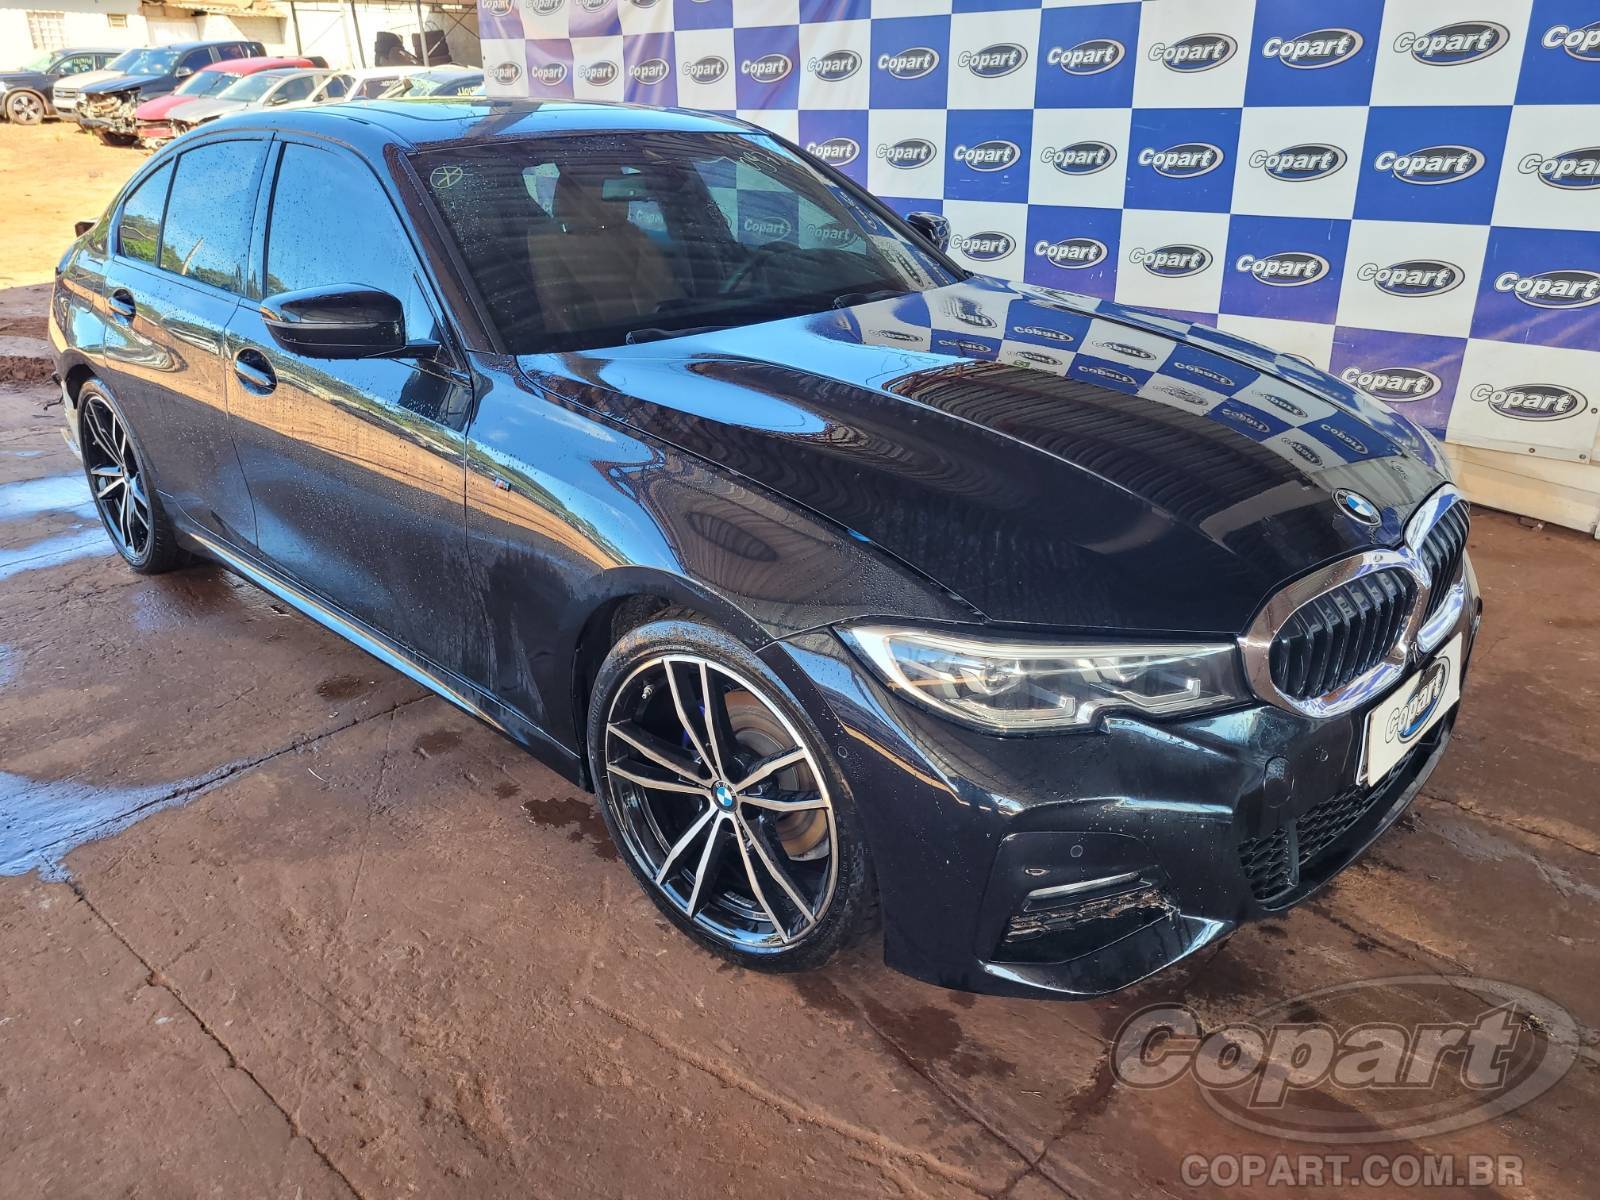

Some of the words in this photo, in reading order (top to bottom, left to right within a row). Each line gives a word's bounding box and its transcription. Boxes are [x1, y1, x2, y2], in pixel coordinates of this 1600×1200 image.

[1047, 42, 1115, 67] Copart
[1148, 38, 1226, 67] Copart
[1262, 32, 1350, 65] Copart
[1393, 26, 1493, 60] Copart
[682, 60, 724, 81] Copart
[740, 57, 786, 76] Copart
[807, 55, 855, 75] Copart
[877, 51, 932, 71] Copart
[957, 47, 1018, 71] Copart
[531, 64, 564, 81] Copart
[578, 63, 613, 81] Copart
[629, 63, 664, 80] Copart
[805, 142, 856, 158] Copart
[876, 142, 930, 161] Copart
[953, 144, 1012, 165] Copart
[1040, 144, 1106, 168] Copart
[1137, 145, 1214, 172] Copart
[1248, 149, 1335, 173] Copart
[1374, 150, 1472, 176] Copart
[950, 234, 1008, 257] Copart
[1033, 240, 1098, 264] Copart
[1129, 246, 1204, 273] Copart
[1235, 253, 1320, 279] Copart
[1357, 262, 1453, 290] Copart
[1494, 271, 1600, 300] Copart
[1340, 365, 1431, 395] Copart
[1470, 383, 1577, 416] Copart
[1385, 662, 1445, 744] Copart
